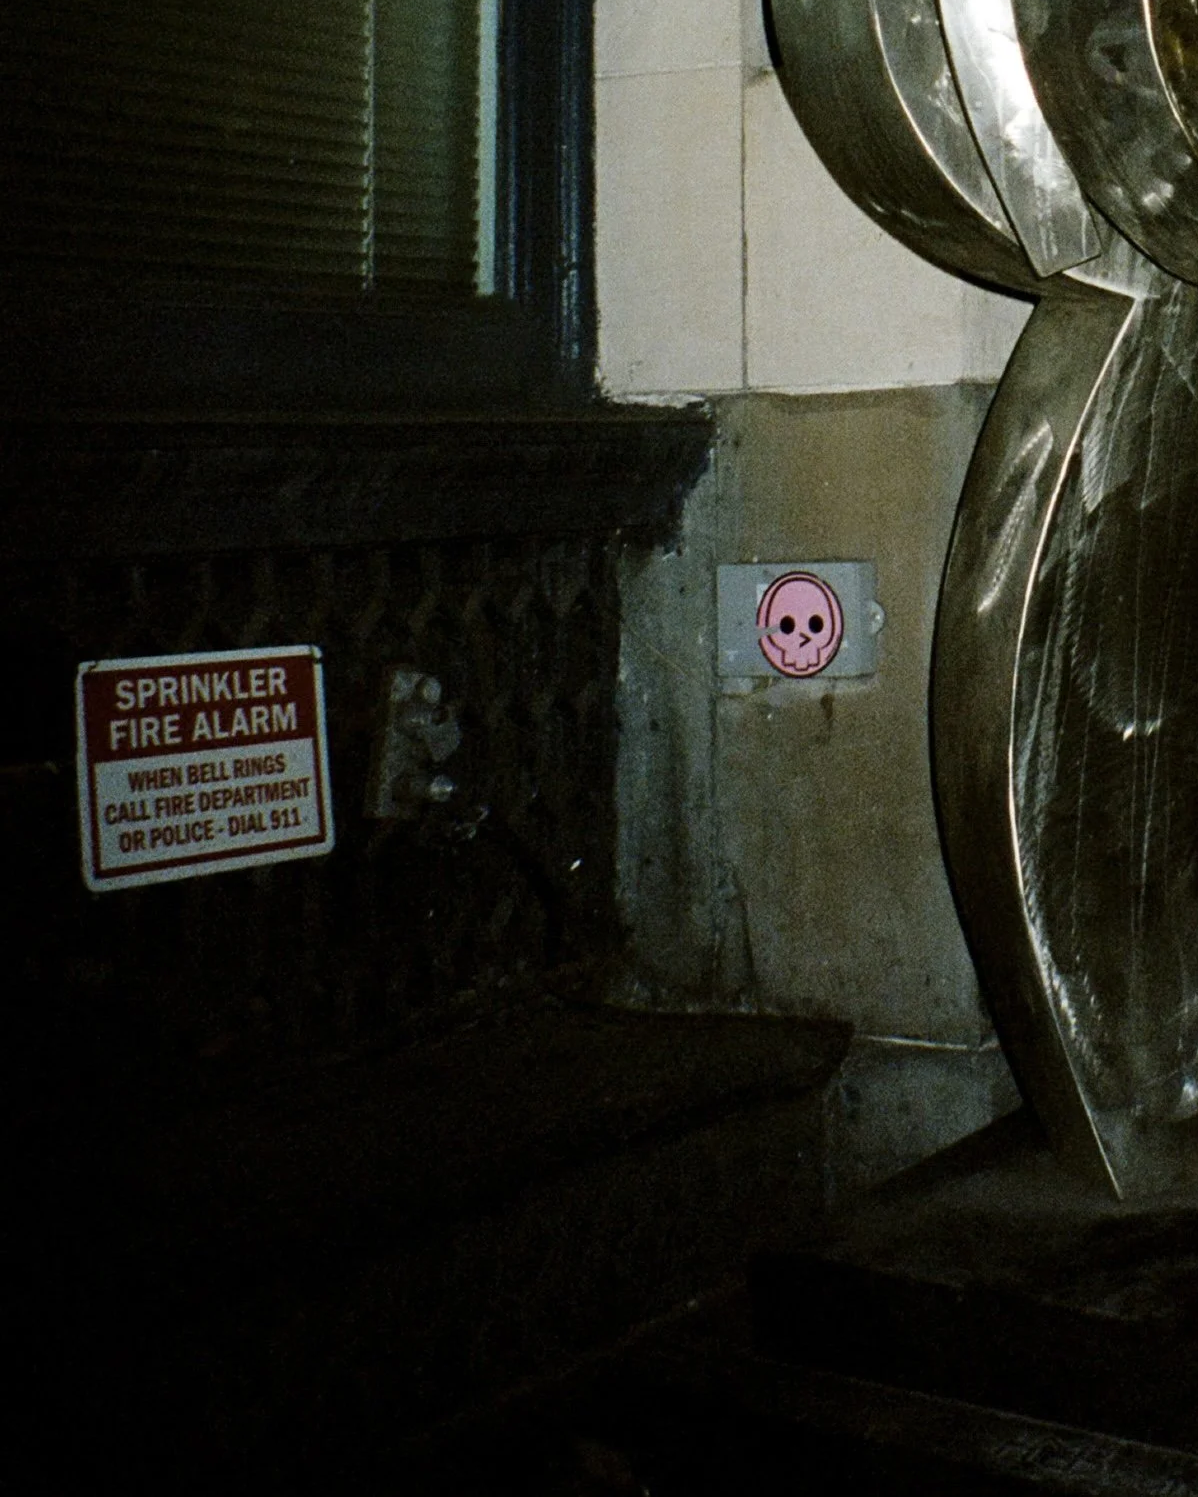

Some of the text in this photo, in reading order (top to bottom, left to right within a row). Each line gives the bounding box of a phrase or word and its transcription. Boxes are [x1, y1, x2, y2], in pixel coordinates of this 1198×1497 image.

[114, 666, 288, 711] SPRINKLER
[109, 702, 298, 752] FIRE ALARM
[128, 753, 286, 792] WHEN BELL RINGS
[105, 778, 310, 824] CALL FIRE DEPARTMENT
[119, 830, 146, 853] OR
[150, 819, 215, 848] POLICE
[227, 811, 267, 836] DIAL
[270, 806, 302, 830] 911
